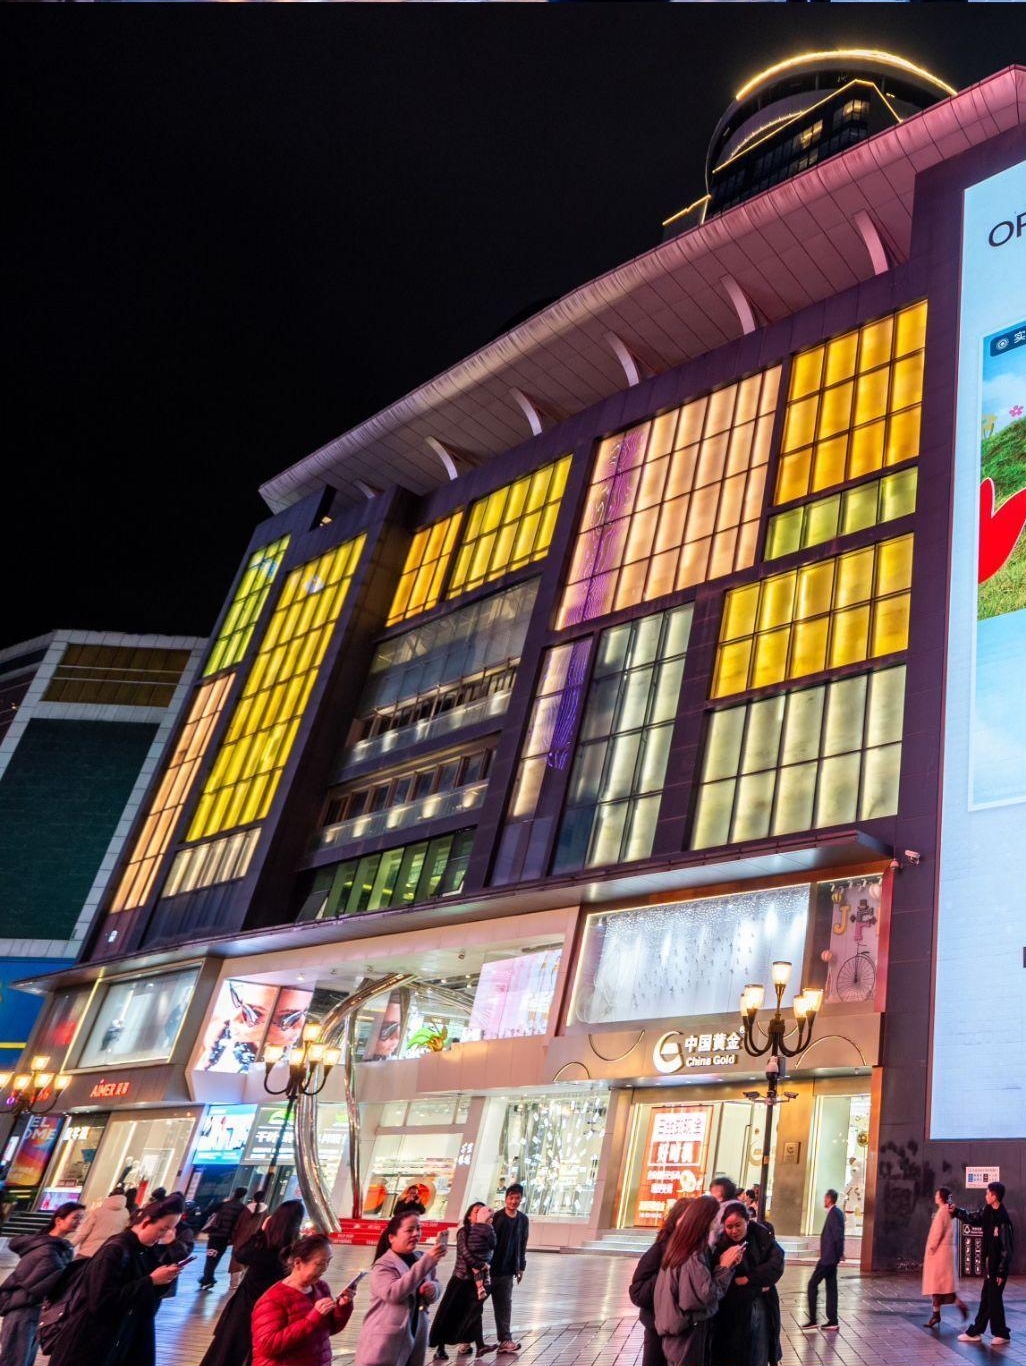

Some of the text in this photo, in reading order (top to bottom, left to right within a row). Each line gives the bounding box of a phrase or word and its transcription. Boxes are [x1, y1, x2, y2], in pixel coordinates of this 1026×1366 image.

[685, 1032, 741, 1053] 中国黄金
[686, 1054, 735, 1067] China Gold
